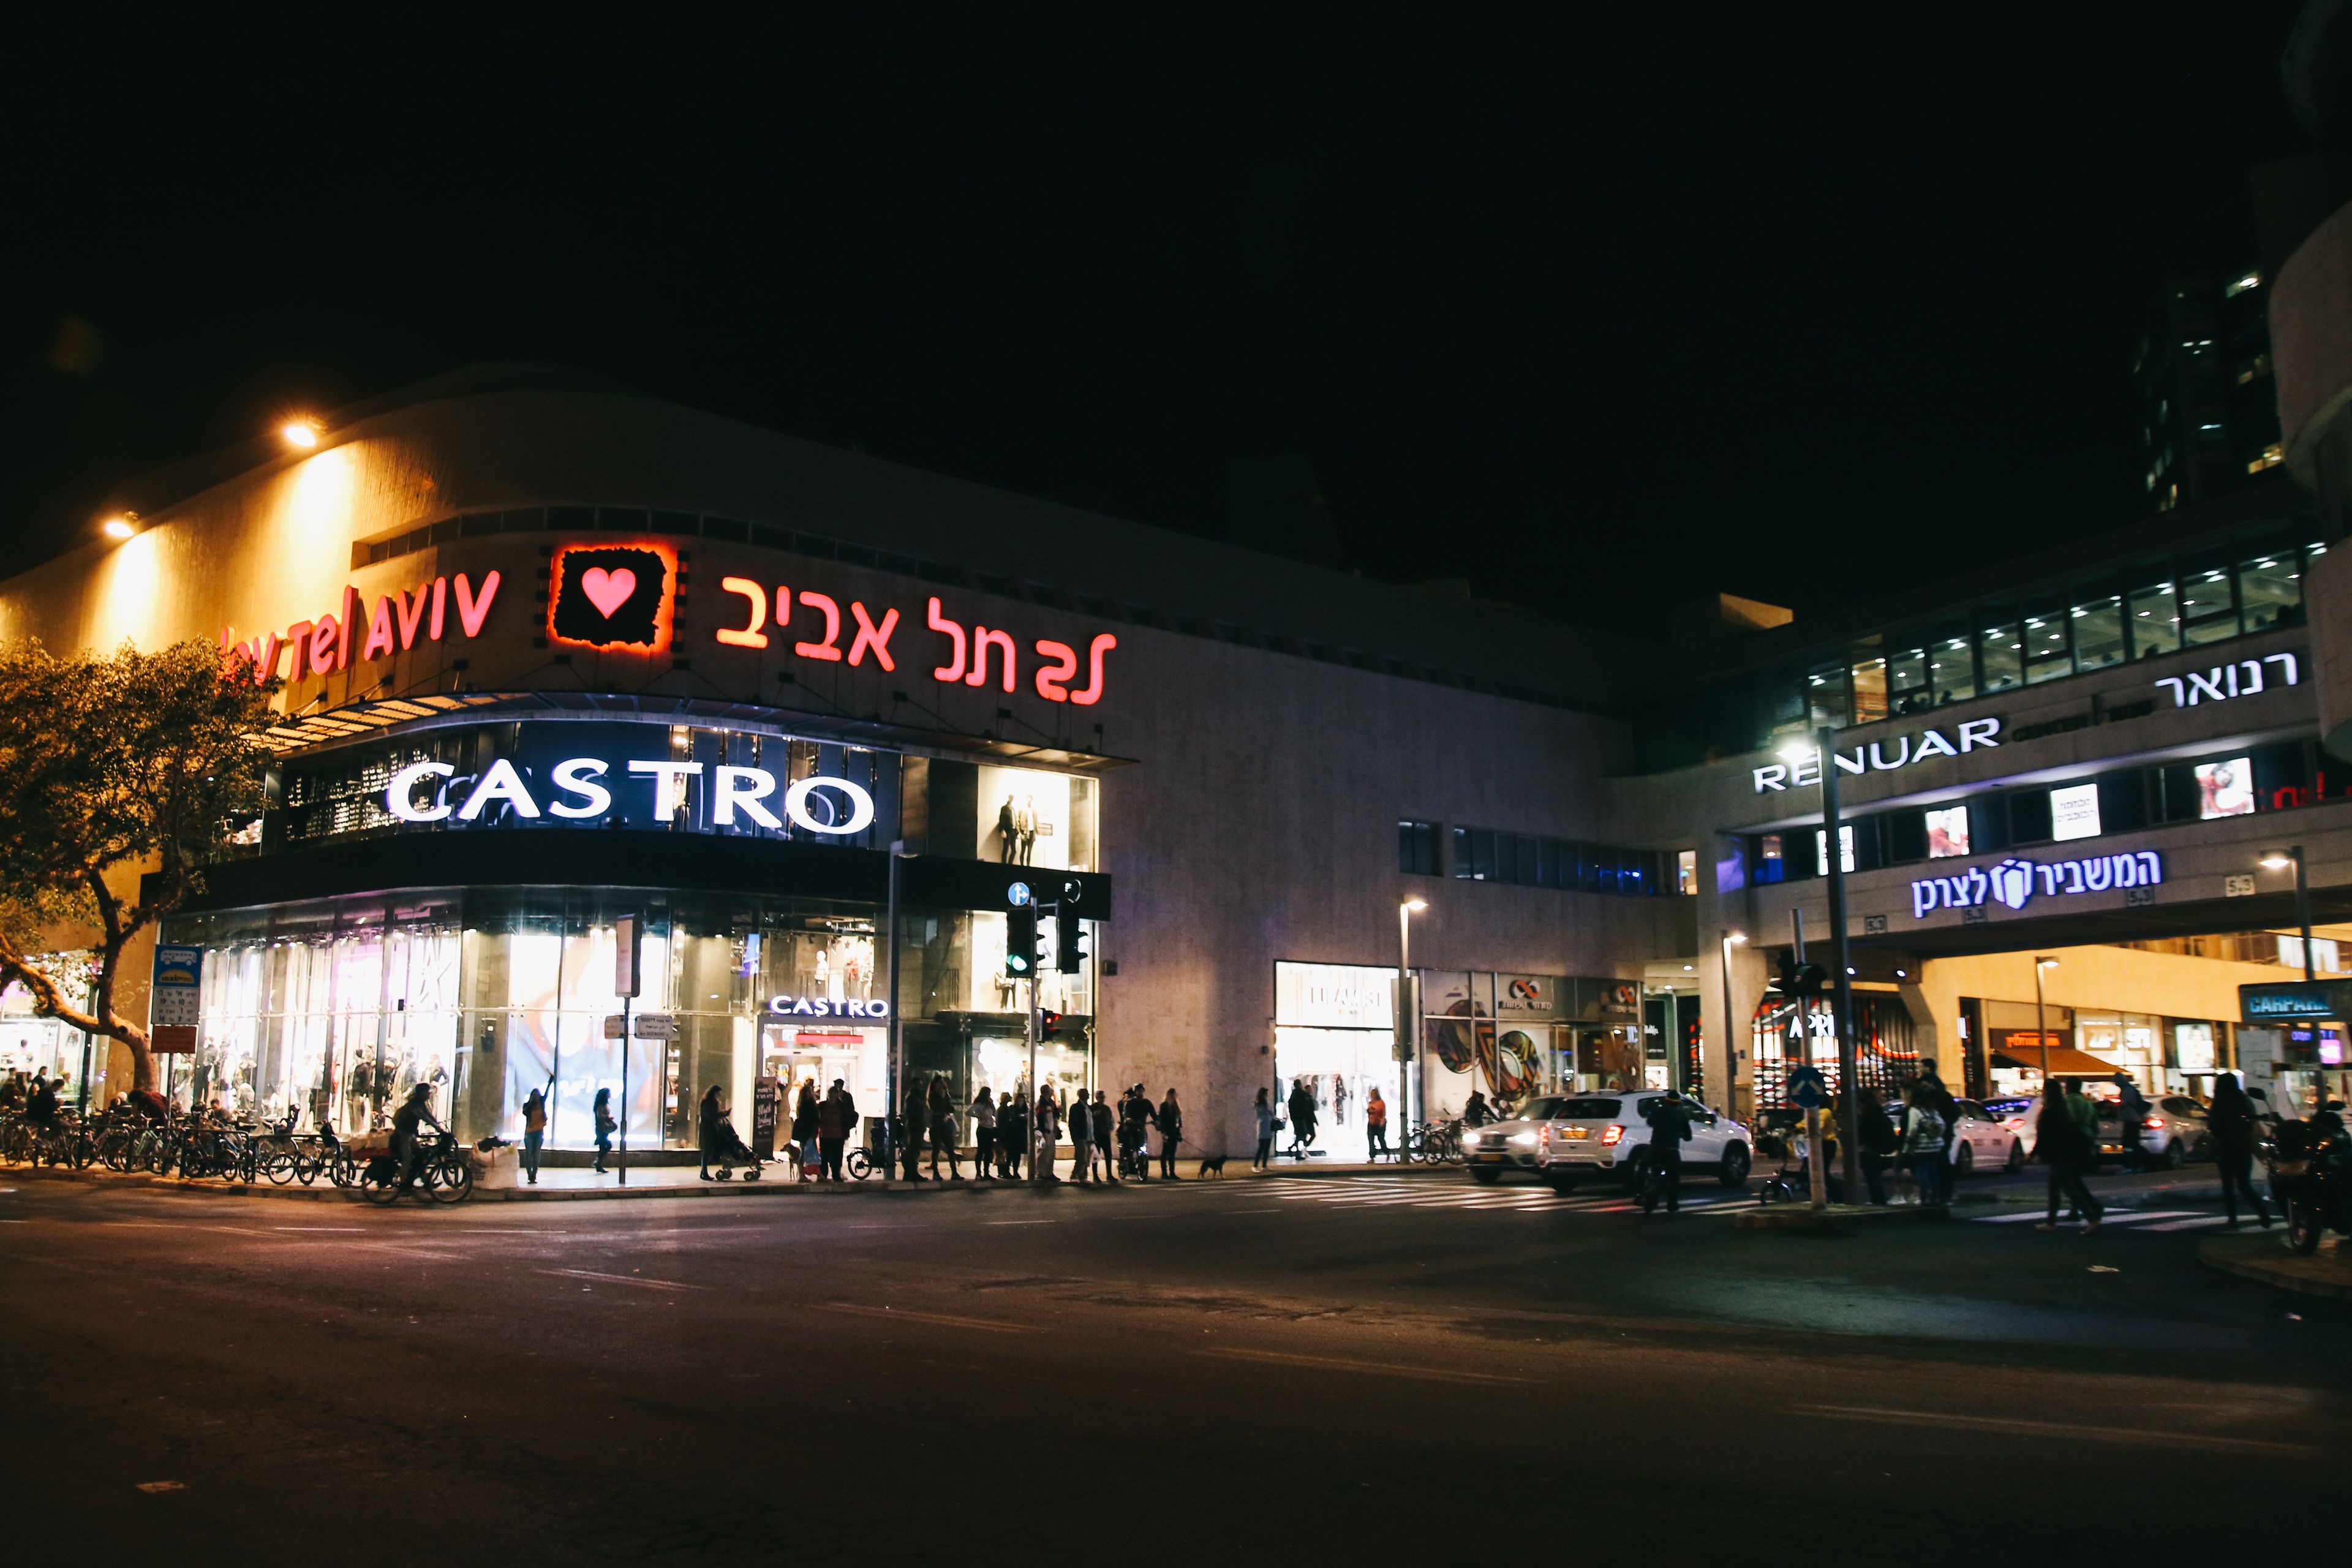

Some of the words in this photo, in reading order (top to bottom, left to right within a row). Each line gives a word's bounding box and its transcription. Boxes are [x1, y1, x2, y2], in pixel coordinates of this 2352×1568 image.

[364, 570, 501, 661] AVIV
[716, 576, 900, 673] אביב
[927, 597, 1016, 693] תל
[2157, 652, 2298, 707] רנואר
[1752, 717, 2001, 794] RENUAR
[386, 758, 875, 835] CASTRO
[1911, 867, 1988, 918] לצרכן
[2035, 851, 2162, 896] המשביר
[2229, 878, 2251, 893] 5.3
[770, 995, 889, 1018] CASTRO
